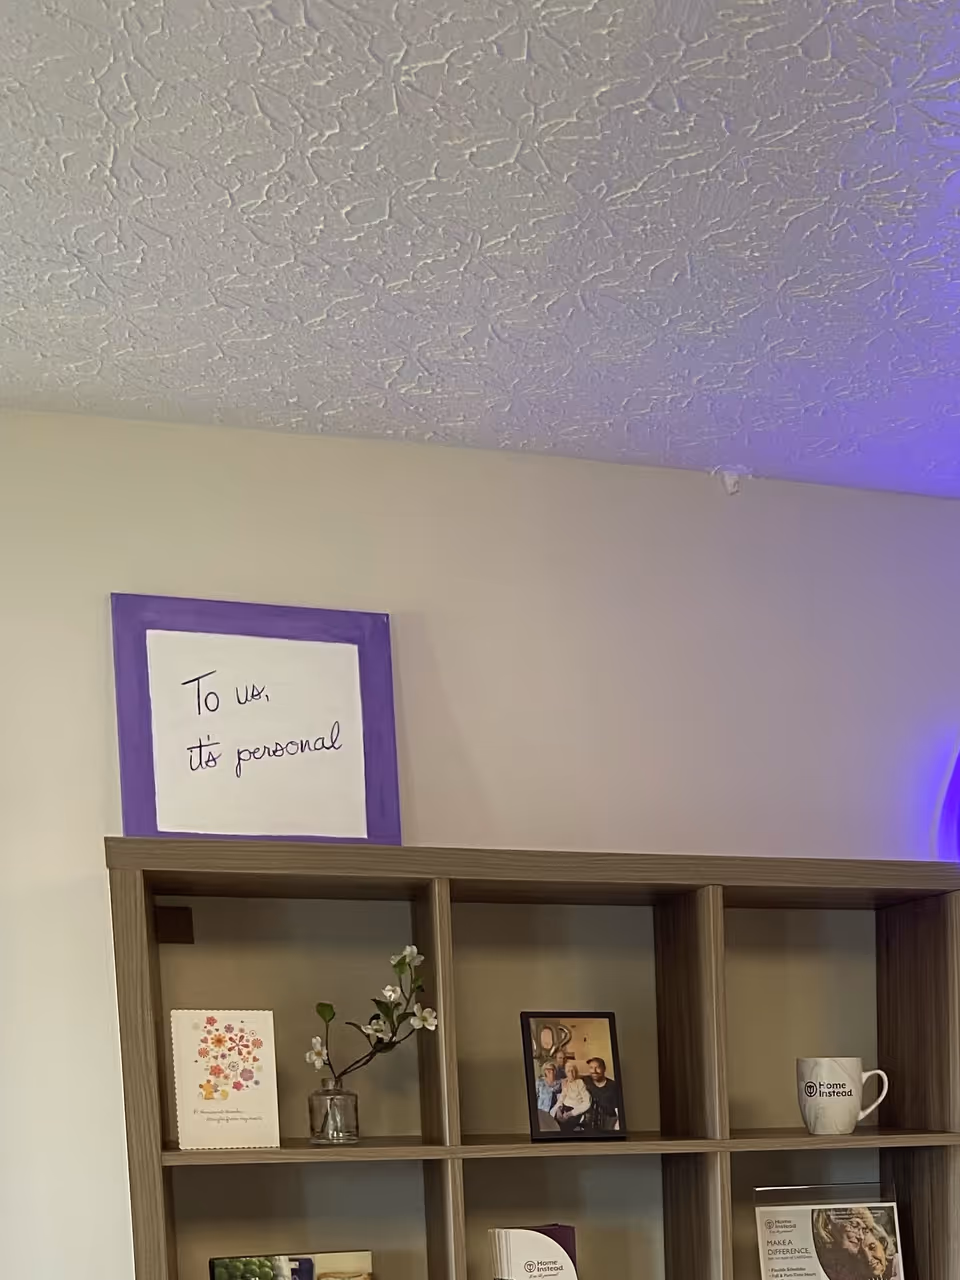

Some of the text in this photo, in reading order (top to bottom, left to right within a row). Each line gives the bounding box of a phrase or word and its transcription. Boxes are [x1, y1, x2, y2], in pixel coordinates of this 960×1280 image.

[181, 670, 219, 715] To
[187, 721, 343, 778] it's personal
[766, 1239, 787, 1247] MAKE
